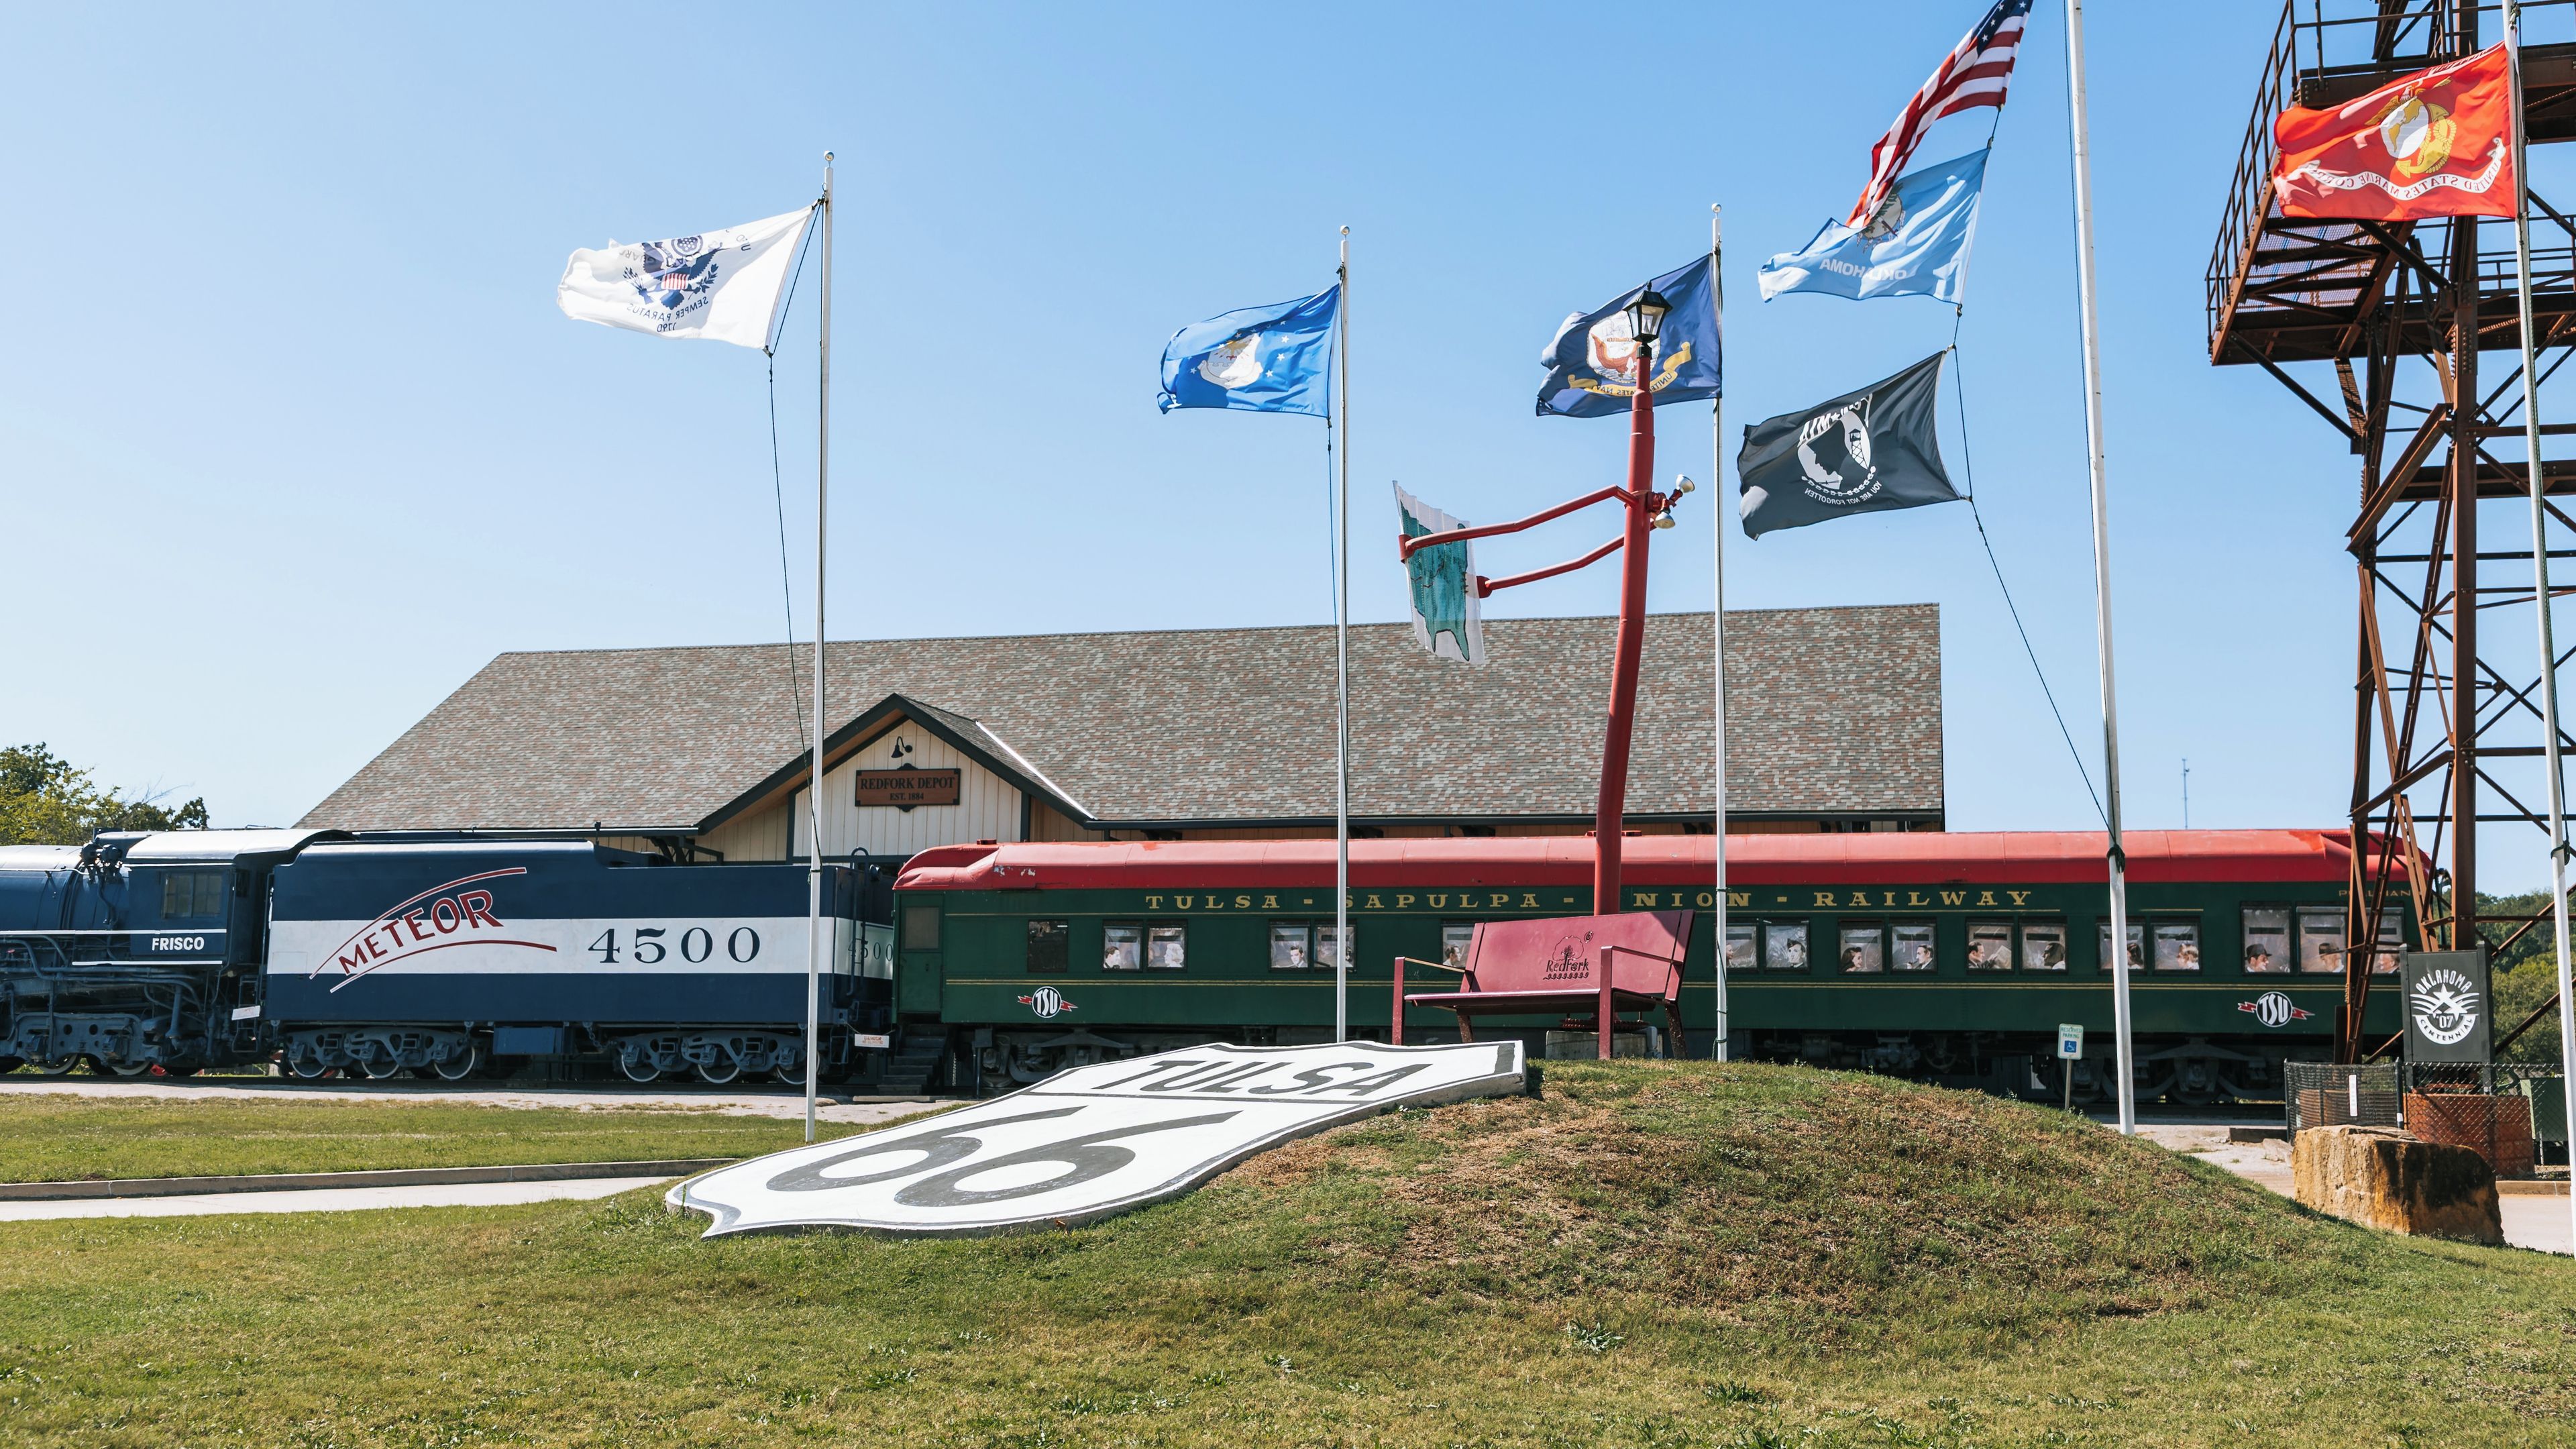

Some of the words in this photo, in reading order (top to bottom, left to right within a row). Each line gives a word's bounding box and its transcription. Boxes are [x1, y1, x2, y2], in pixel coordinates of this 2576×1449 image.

[860, 777, 914, 790] REDFORK
[918, 777, 955, 789] DEPOT
[908, 792, 924, 800] 1884
[1146, 895, 1280, 909] TULSA
[1633, 892, 1752, 907] NION
[1813, 891, 2032, 907] RAILWAY
[152, 936, 205, 951] FRISCO
[338, 890, 504, 976] METEOR
[587, 926, 761, 964] 4500
[2415, 969, 2473, 995] OKLAHOMA
[1035, 988, 1058, 1016] TSU
[2259, 994, 2288, 1025] TSU
[2420, 1019, 2473, 1041] CENTENNIAL
[1092, 1060, 1432, 1096] TULSA
[766, 1106, 1243, 1208] 66
